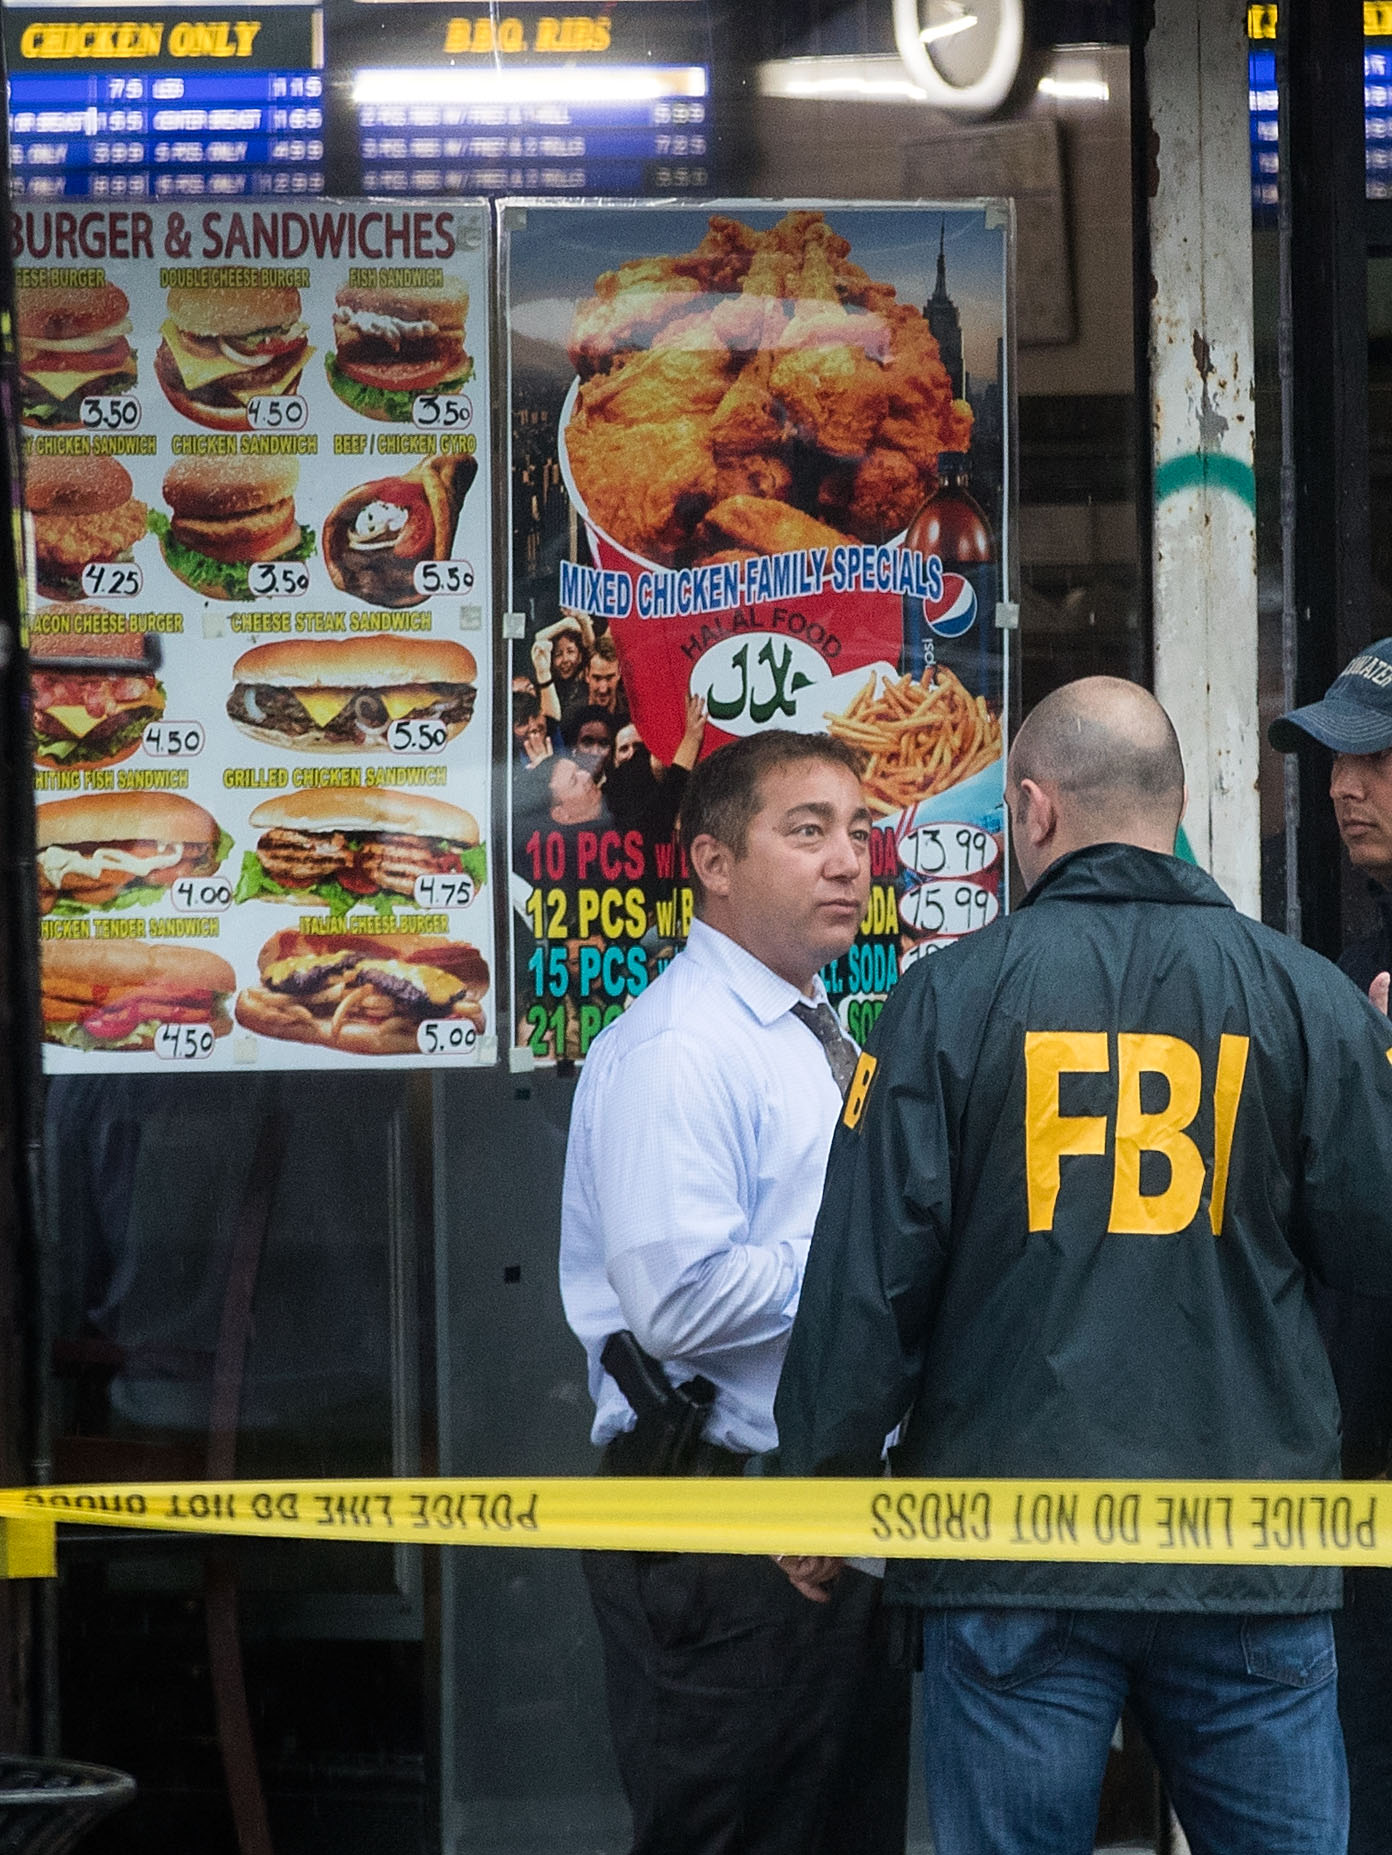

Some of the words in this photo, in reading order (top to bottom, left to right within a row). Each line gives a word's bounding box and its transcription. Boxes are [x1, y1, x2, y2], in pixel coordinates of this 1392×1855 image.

[20, 22, 164, 58] CHICKEN
[168, 21, 262, 57] ONLY
[10, 211, 154, 259] BURGER
[164, 211, 192, 259] &
[202, 211, 456, 259] SANDWICHES
[50, 267, 106, 289] BURGER
[160, 267, 208, 289] DOUBLE
[209, 267, 258, 289] CHEESE
[260, 267, 311, 289] BURGER
[350, 267, 377, 289] FISH
[379, 267, 444, 289] SANDWICH
[83, 399, 138, 428] 3.50
[248, 400, 303, 427] 4.50
[418, 395, 471, 426] 3.50
[36, 435, 91, 456] CHICKEN
[92, 435, 157, 456] SANDWICH
[172, 435, 238, 456] CHICKEN
[240, 435, 318, 456] SANDWICH
[334, 434, 369, 455] BEEF
[377, 434, 437, 455] CHICKEN
[440, 434, 477, 455] GYRO
[85, 564, 139, 595] 4.25
[253, 563, 309, 593] 3.50
[559, 560, 632, 618] MIXED
[636, 564, 740, 619] CHICKEN
[743, 549, 828, 604] FAMILY
[832, 544, 943, 603] SPECIALS
[28, 612, 70, 634] ACON
[74, 612, 126, 634] CHEESE
[128, 612, 184, 633] BURGER
[231, 612, 290, 633] CHEESE
[295, 611, 346, 632] STEAK
[350, 610, 432, 632] SANDWICH
[680, 606, 764, 660] HALAL
[772, 607, 842, 659] FOOD
[146, 728, 200, 755] 4.50
[393, 721, 447, 751] 5.50
[34, 769, 80, 791] HITING
[84, 769, 114, 790] FISH
[118, 768, 189, 790] SANDWICH
[223, 767, 288, 789] GRILLED
[292, 766, 364, 788] CHICKEN
[365, 765, 447, 787] SANDWICH
[525, 830, 566, 881] 10
[577, 830, 646, 881] PCS
[178, 883, 231, 907] 4.00
[420, 877, 471, 906] 4.75
[41, 919, 89, 939] HICKEN
[93, 919, 146, 939] TENDER
[149, 917, 220, 938] SANDWICH
[299, 915, 348, 936] ITALIAN
[351, 915, 396, 935] CHEESE
[399, 914, 450, 935] BURGER
[526, 887, 568, 939] 12
[578, 887, 647, 939] PCS
[527, 945, 569, 998] 15
[580, 945, 649, 998] PCS
[847, 942, 898, 994] SODA
[163, 1023, 214, 1058] 4.50
[425, 1024, 476, 1053] 5.00
[527, 1004, 567, 1056] 21
[1024, 1031, 1250, 1237] FBI
[871, 1491, 992, 1543] CROSS
[1010, 1493, 1079, 1545] NOT
[1094, 1493, 1141, 1545] DO
[1156, 1496, 1234, 1550] LINE
[1251, 1495, 1378, 1551] POLICE
